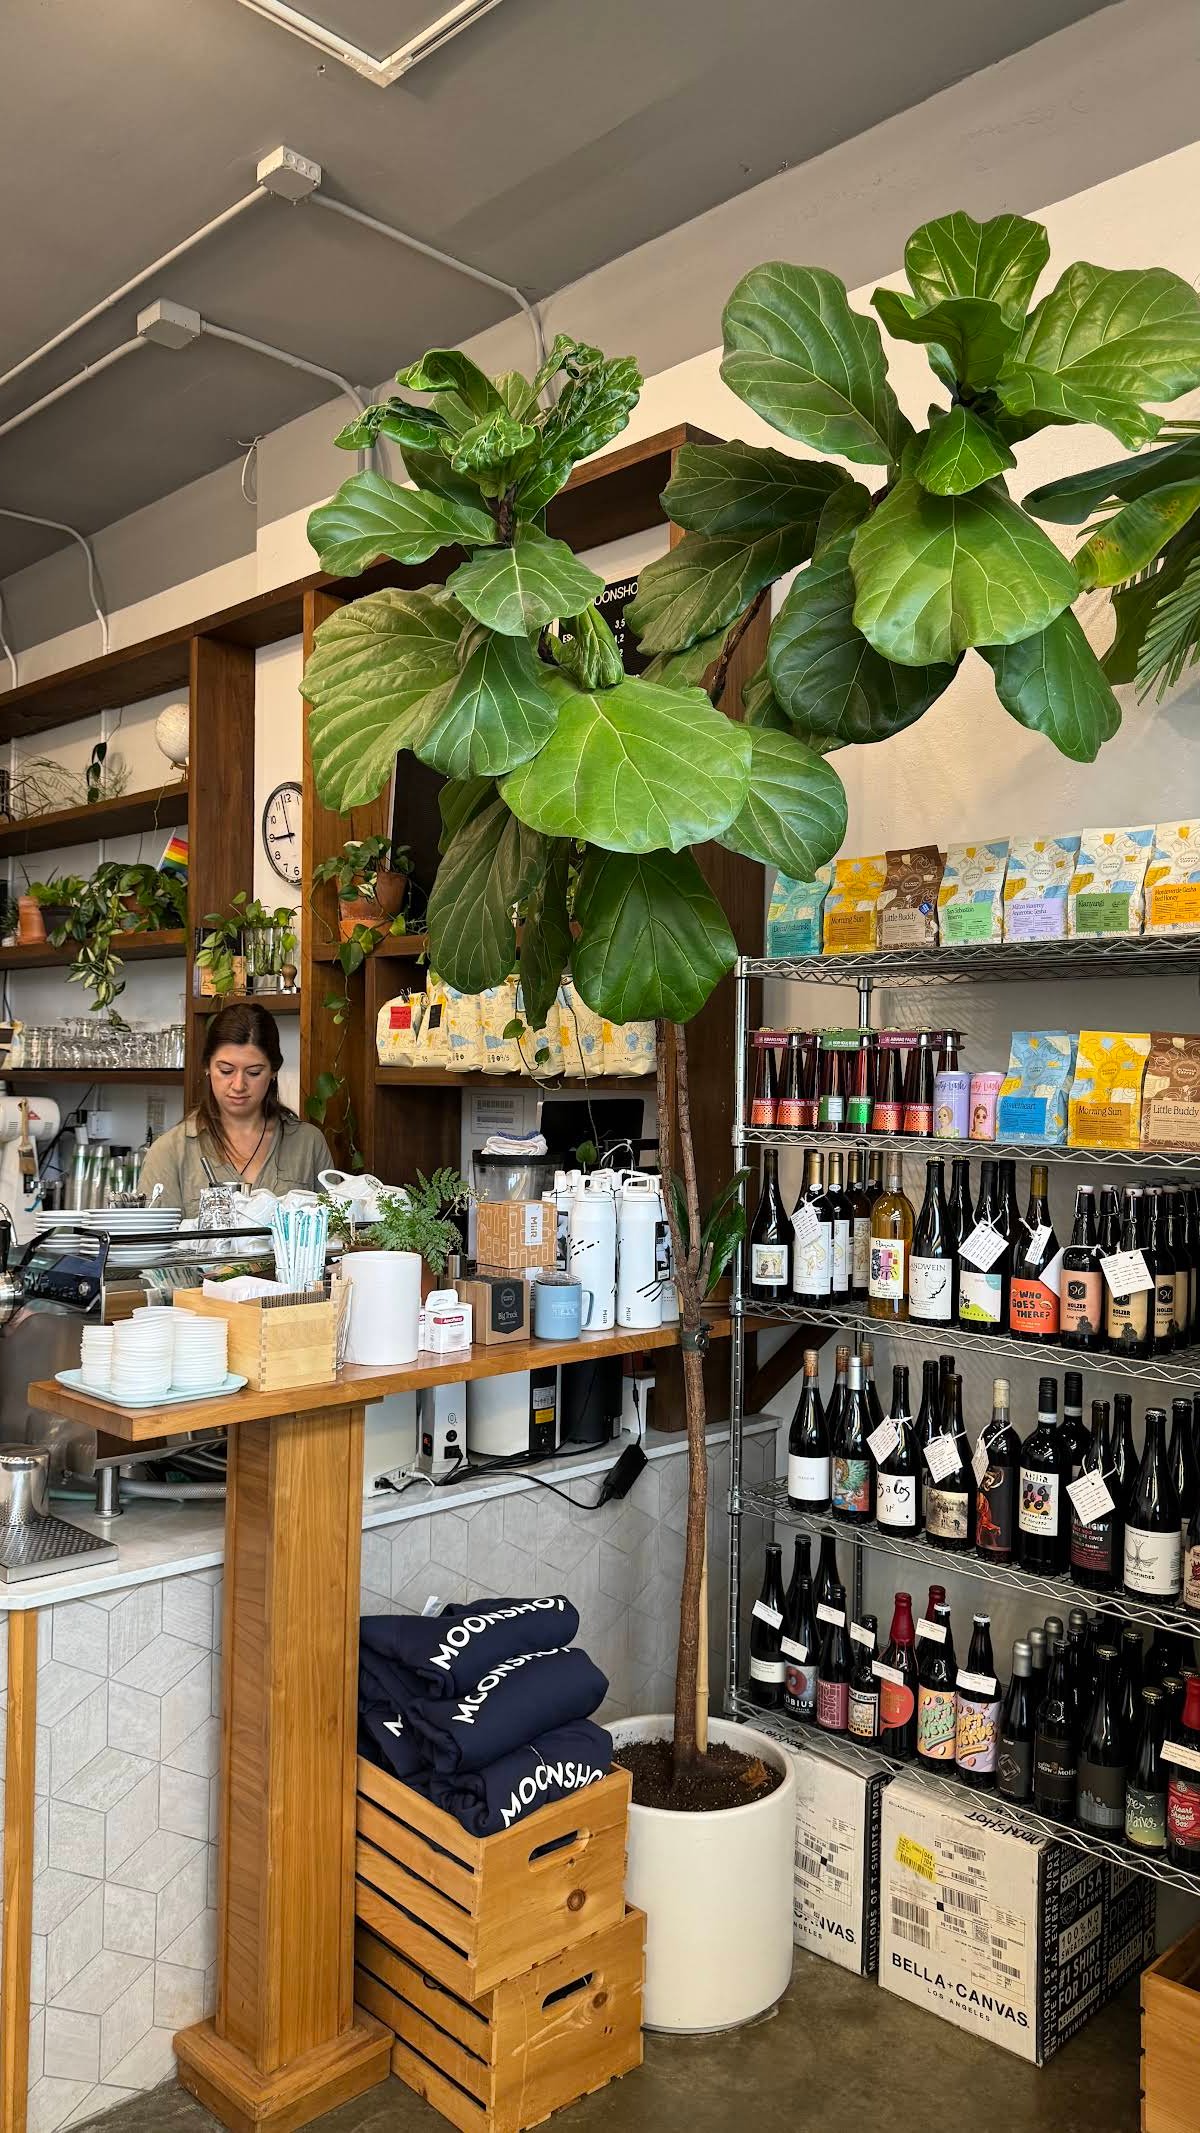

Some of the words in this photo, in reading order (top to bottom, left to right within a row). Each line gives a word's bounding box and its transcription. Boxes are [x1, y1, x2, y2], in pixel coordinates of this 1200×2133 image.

[594, 581, 638, 606] OONSHO
[270, 815, 277, 825] 10
[269, 833, 275, 843] 9
[274, 851, 281, 860] 8
[283, 863, 289, 873] 7
[293, 866, 300, 876] 6
[831, 916, 852, 925] Morning
[853, 915, 864, 923] Sun
[884, 913, 898, 922] Little
[898, 912, 917, 922] Buddy
[1002, 1100, 1036, 1110] Sweetheart
[1078, 1105, 1107, 1117] Morning
[1107, 1106, 1122, 1116] Sun
[1153, 1104, 1172, 1115] Little
[1173, 1105, 1200, 1117] Buddy
[1019, 1290, 1042, 1299] WHO
[1012, 1299, 1036, 1309] GOES
[506, 1311, 518, 1319] Truck
[1016, 1309, 1051, 1320] THERE?
[784, 1694, 814, 1708] OBIUS
[872, 1782, 880, 1819] MADE
[1173, 1803, 1193, 1814] Heart
[1170, 1811, 1195, 1821] Shaped
[1175, 1818, 1189, 1828] Box
[871, 1823, 879, 1884] T-SHIRTS
[1046, 1852, 1054, 1892] MADE
[1052, 1848, 1060, 1888] YEAR
[1079, 1868, 1102, 1899] USA
[870, 1888, 878, 1904] OF
[1051, 1895, 1059, 1942] EVERY
[793, 1910, 857, 1945] NVAS.
[793, 1921, 823, 1940] NGELES
[1044, 1896, 1052, 1962] T-SHIRTS
[1061, 1922, 1086, 1946] 100%
[1087, 1910, 1099, 1925] NO
[869, 1910, 878, 1971] MILLIONS
[1061, 1924, 1099, 1960] SWEATSHOPS
[1059, 1965, 1070, 1989] #1
[1073, 1939, 1101, 1978] SHIRT
[1044, 1967, 1051, 1985] OF
[891, 1952, 1030, 2029] BELLA+CANVAS.
[1058, 1980, 1079, 2011] FOR
[1082, 1961, 1101, 1992] DTG
[927, 1987, 944, 2000] LOS
[949, 1999, 991, 2022] ANGELES
[1057, 2012, 1088, 2047] PLATINUM
